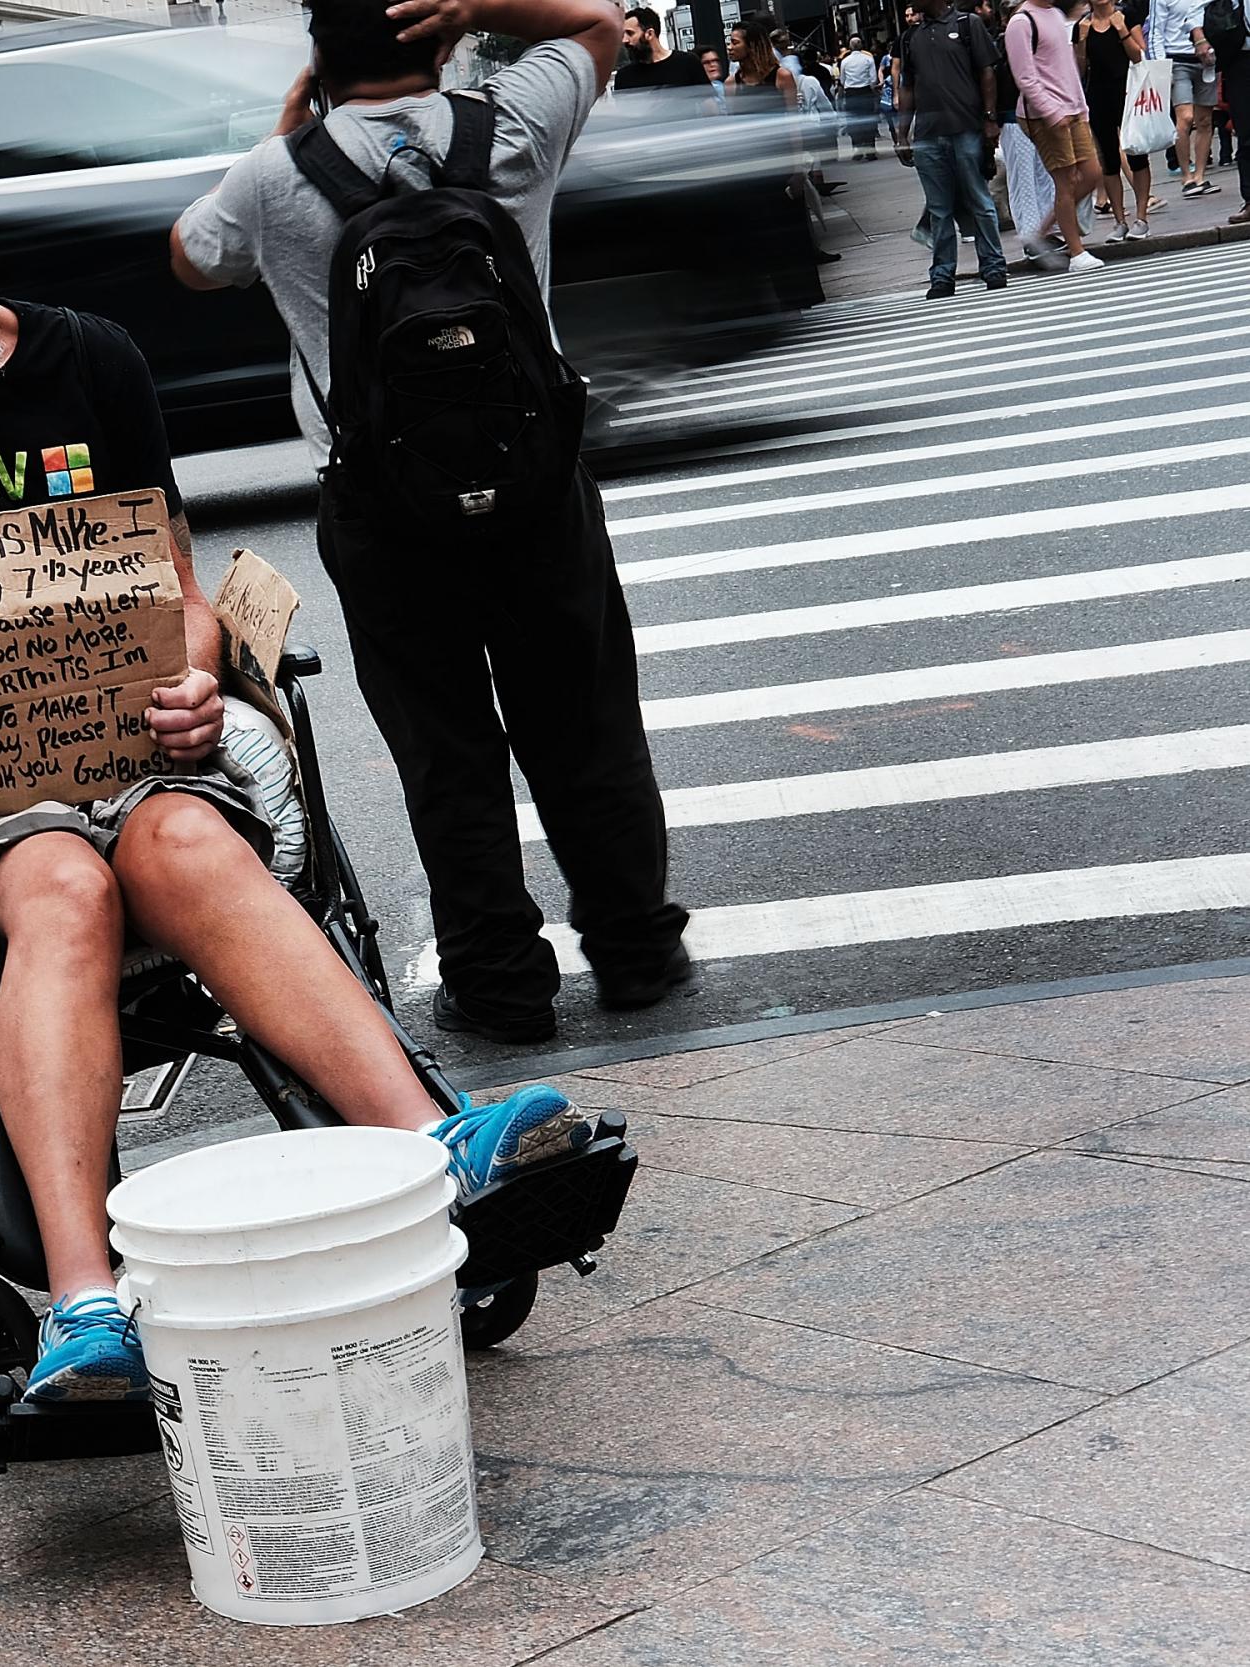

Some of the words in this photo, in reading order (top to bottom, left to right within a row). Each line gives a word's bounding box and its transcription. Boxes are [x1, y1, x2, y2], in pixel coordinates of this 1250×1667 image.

[1134, 87, 1163, 116] H&M
[117, 497, 157, 539] I
[26, 633, 59, 660] No
[188, 1364, 217, 1373] Concrete
